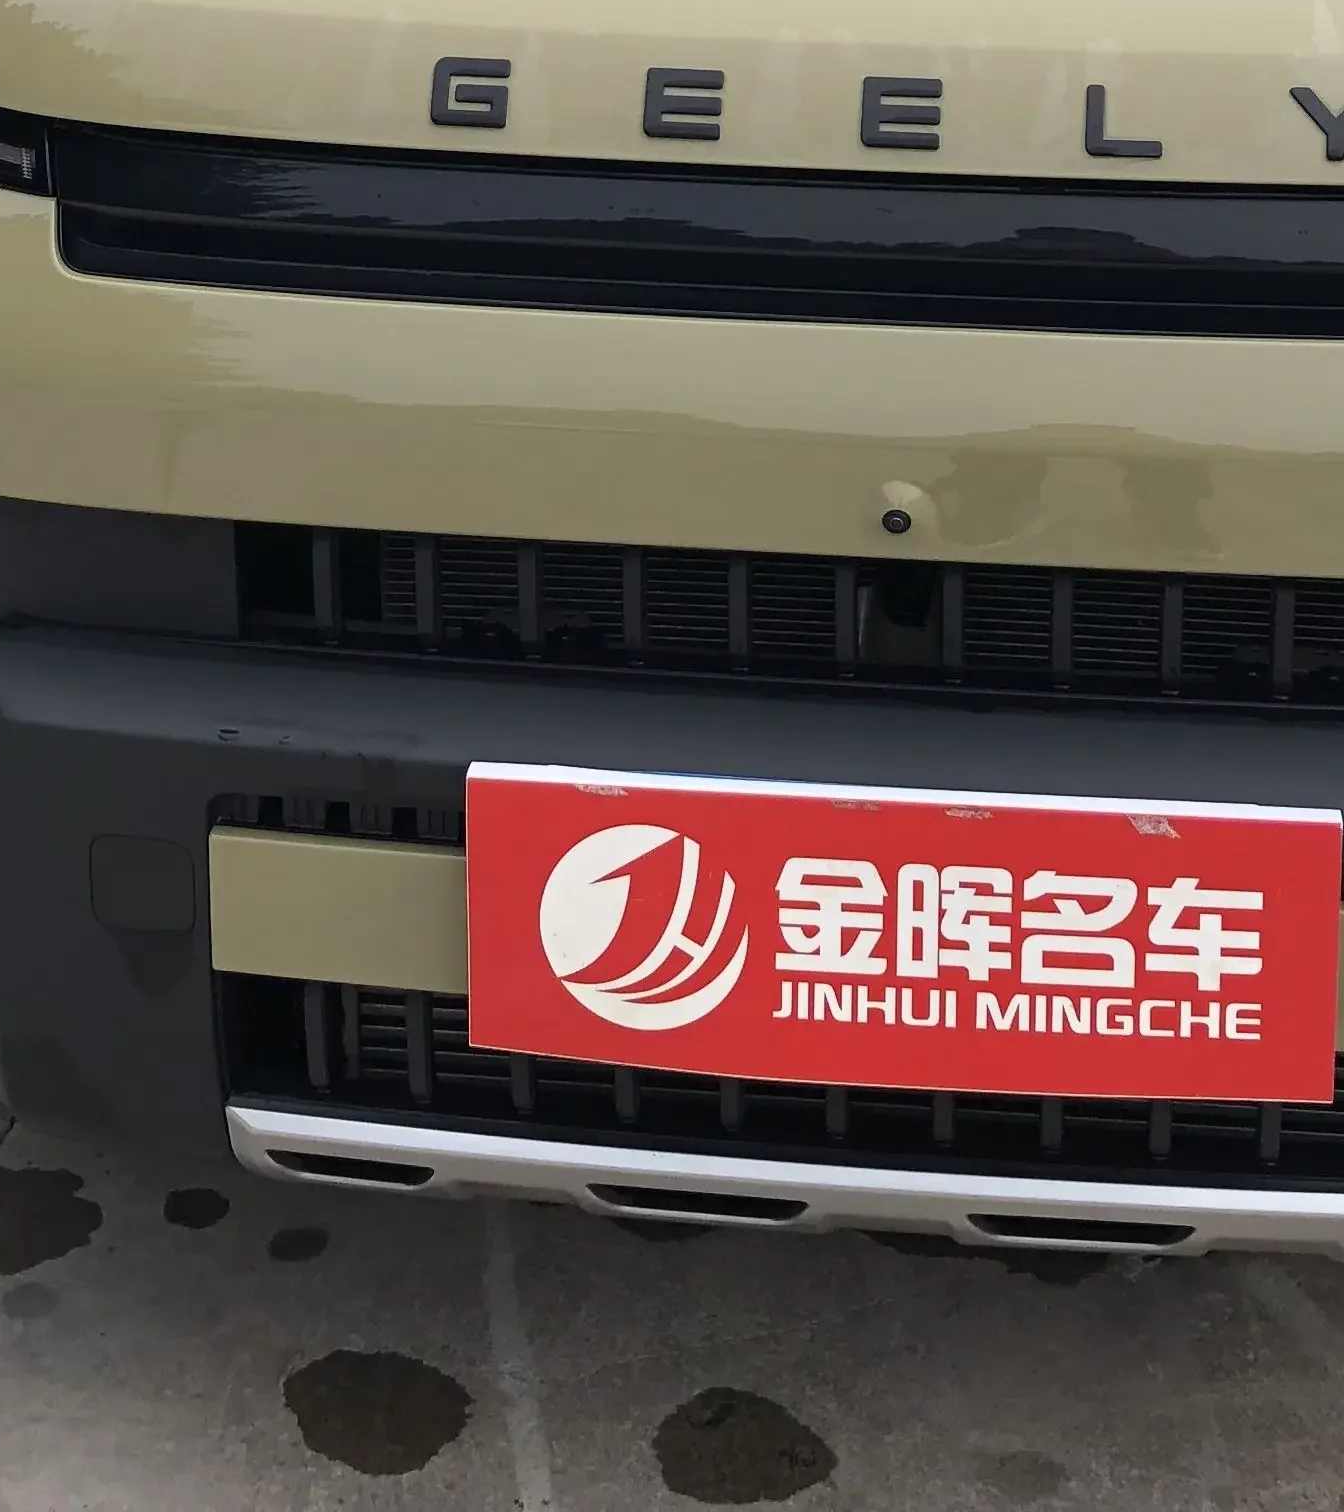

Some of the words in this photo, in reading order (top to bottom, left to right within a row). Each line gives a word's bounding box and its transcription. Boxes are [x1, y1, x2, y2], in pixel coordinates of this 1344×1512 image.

[775, 856, 1263, 991] 金晖名车
[773, 981, 957, 1028] JINHUI
[976, 992, 1262, 1040] MINGCHE
